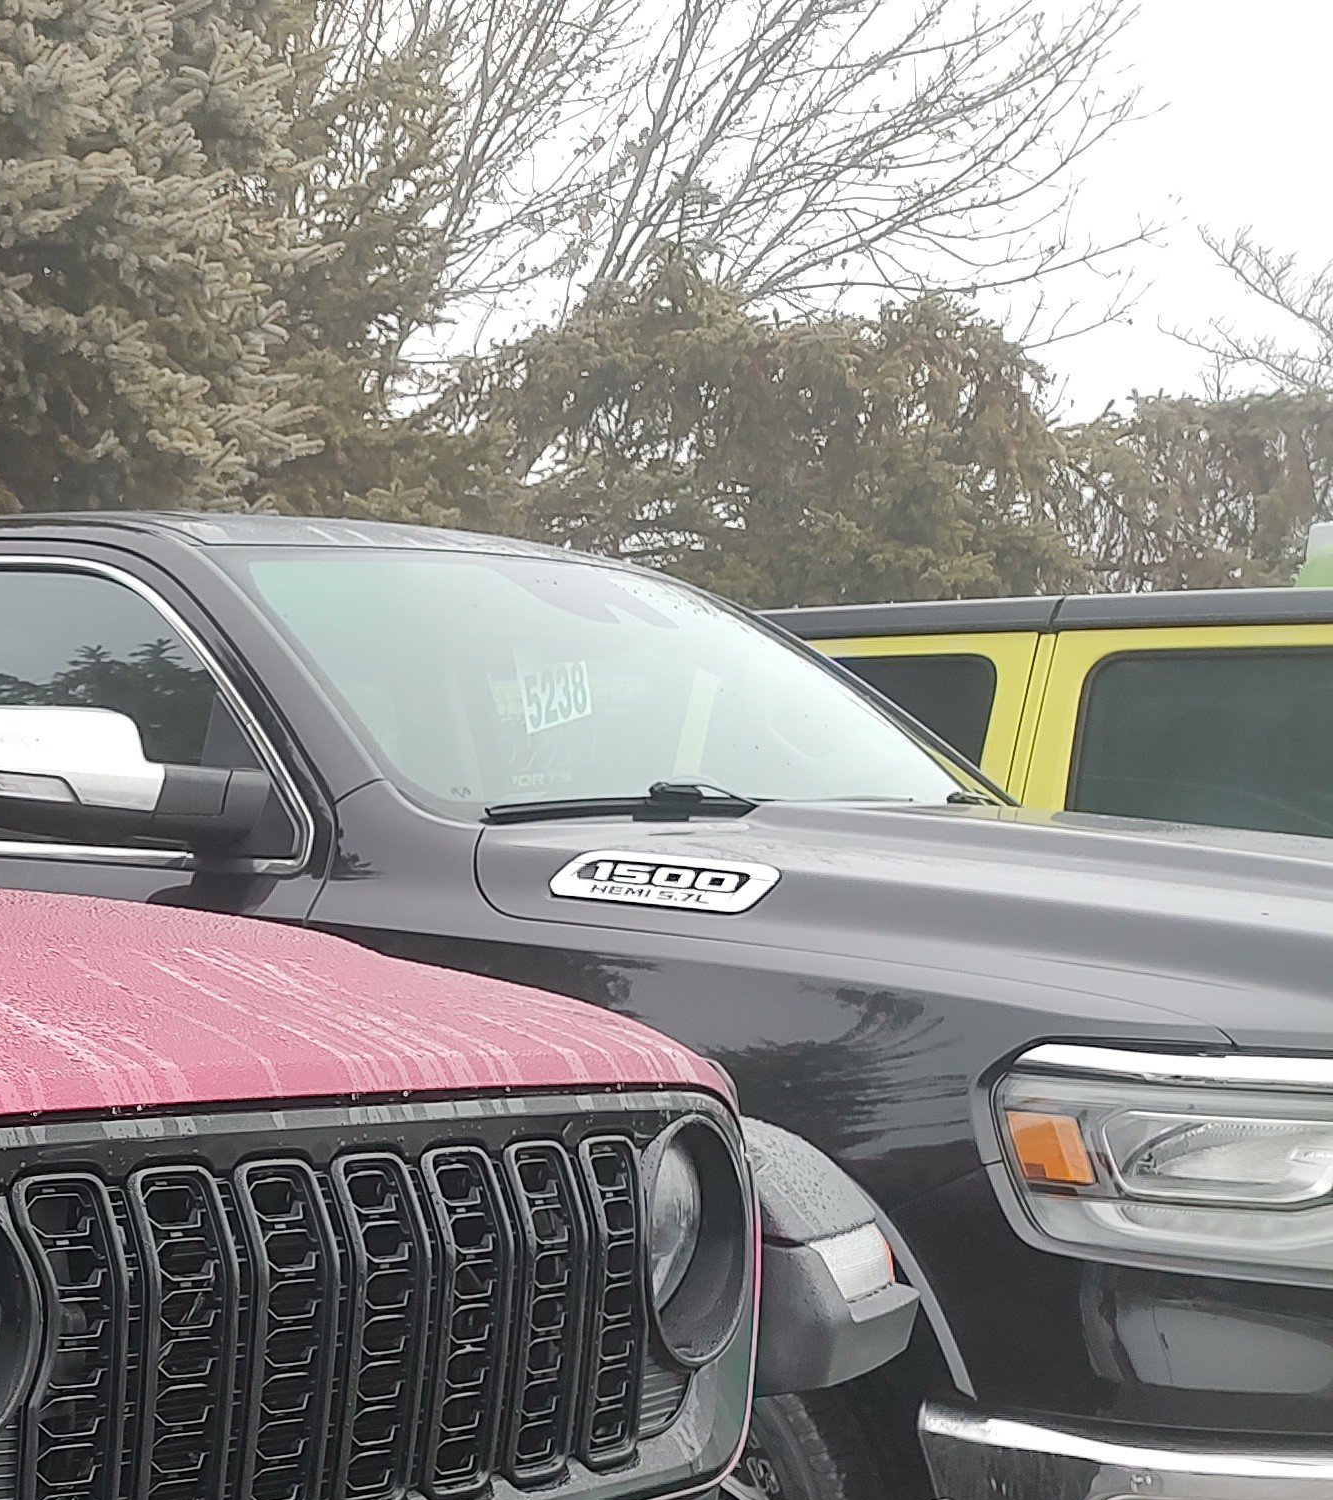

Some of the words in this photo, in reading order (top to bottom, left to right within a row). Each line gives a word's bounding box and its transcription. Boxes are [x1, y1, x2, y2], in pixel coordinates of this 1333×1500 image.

[524, 662, 588, 730] 5238
[592, 861, 741, 894] 1500
[589, 884, 652, 898] HEMI
[656, 890, 711, 905] 5.7L
